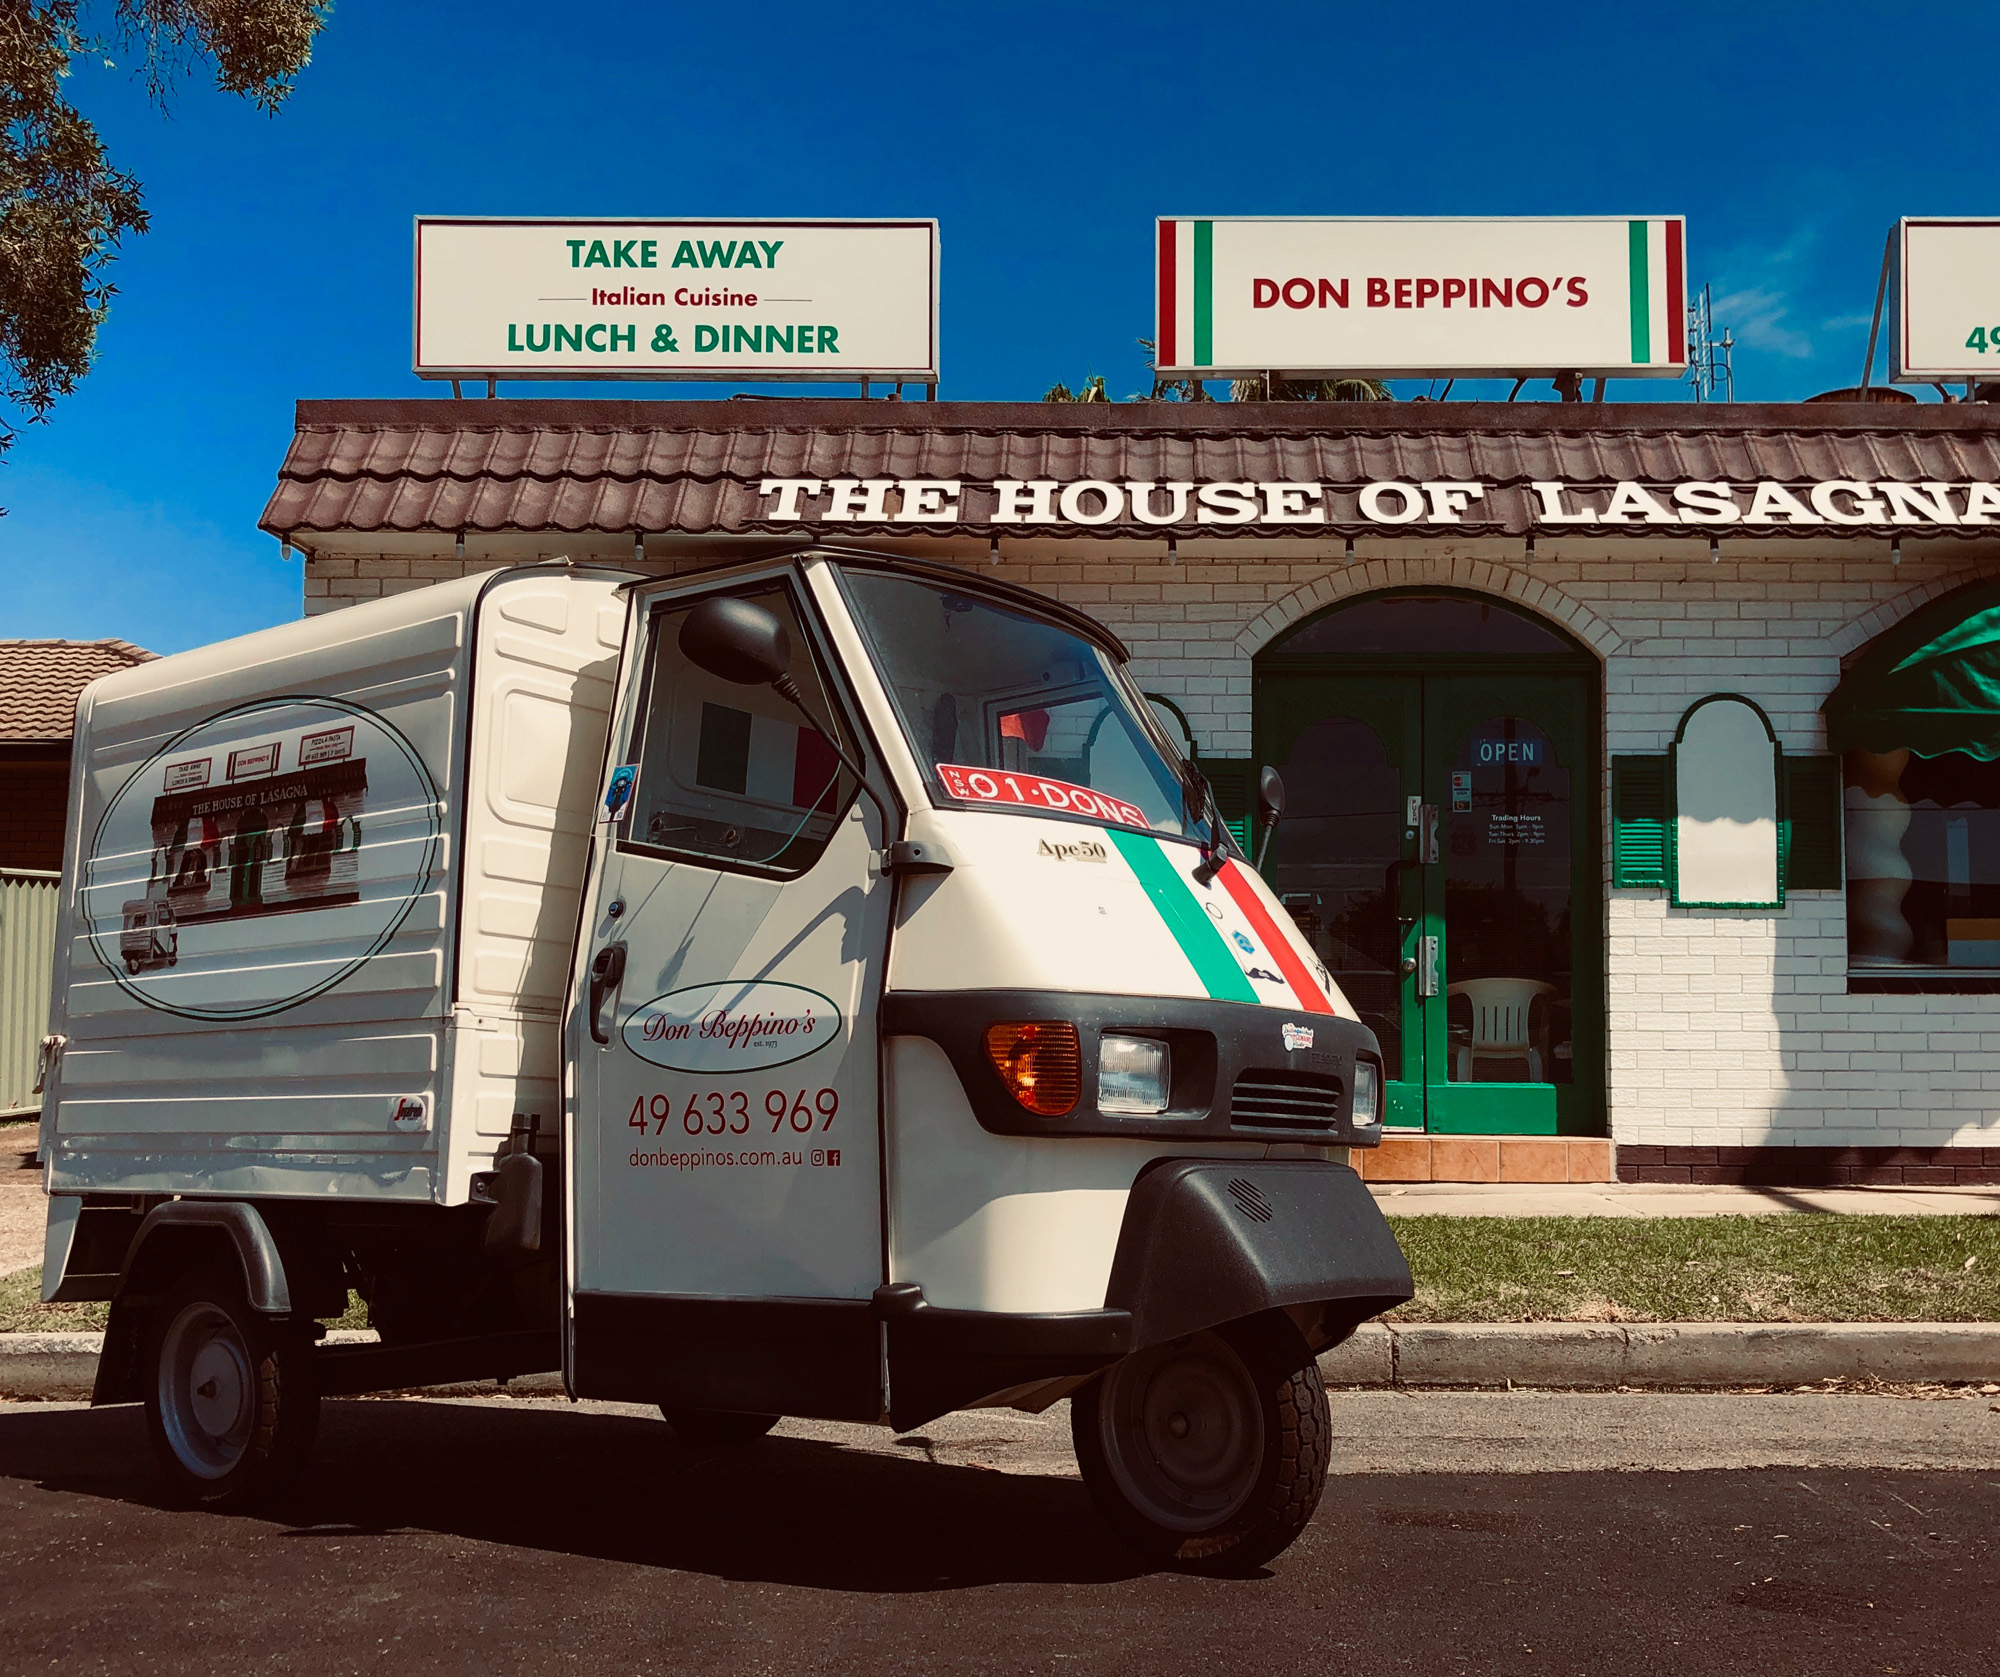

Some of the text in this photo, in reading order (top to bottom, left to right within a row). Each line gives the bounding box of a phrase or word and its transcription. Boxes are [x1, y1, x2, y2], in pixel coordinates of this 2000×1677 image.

[566, 240, 785, 269] TAKE AWAY
[591, 287, 758, 307] Italian Cuisine
[1252, 276, 1589, 309] DON BEPPINO’S
[507, 323, 840, 354] LUNCH & DINNER
[759, 479, 2000, 525] THE HOUSE OF LASAGNA
[1480, 743, 1534, 761] OPEN
[192, 784, 308, 816] THE HOUSE OF LASAGNA
[1492, 814, 1519, 823] Trading
[643, 1008, 817, 1050] Don Beppino’s
[765, 1040, 778, 1049] 1973
[628, 1088, 840, 1137] 49 633 969
[628, 1148, 804, 1172] donbeppinos.com.au
